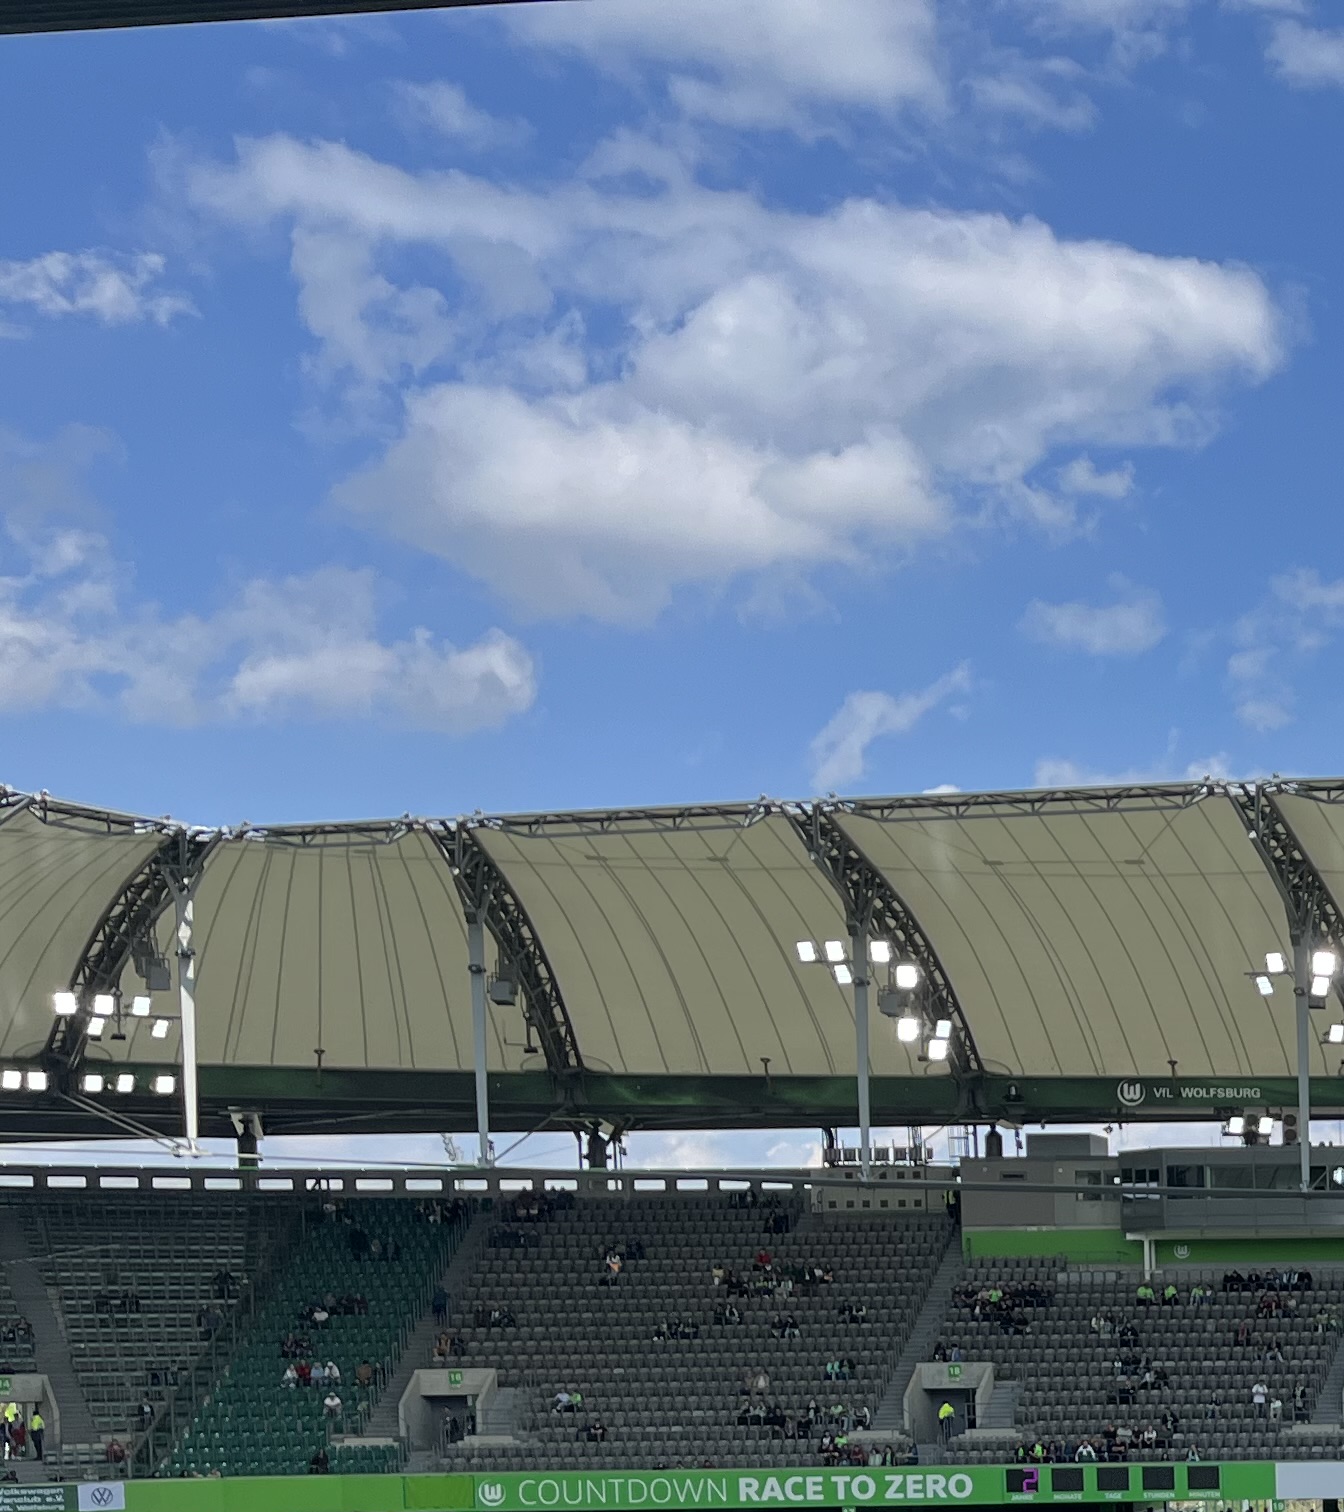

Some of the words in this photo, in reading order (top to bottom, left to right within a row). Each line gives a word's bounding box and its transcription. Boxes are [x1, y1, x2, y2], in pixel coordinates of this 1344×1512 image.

[1153, 1087, 1173, 1098] VfL
[1180, 1087, 1261, 1098] WOLFSBURG
[518, 1477, 727, 1504] COUNTDOWN
[738, 1475, 825, 1502] RACE
[831, 1474, 876, 1500] TO
[884, 1472, 974, 1500] ZERO
[1022, 1467, 1038, 1493] 2
